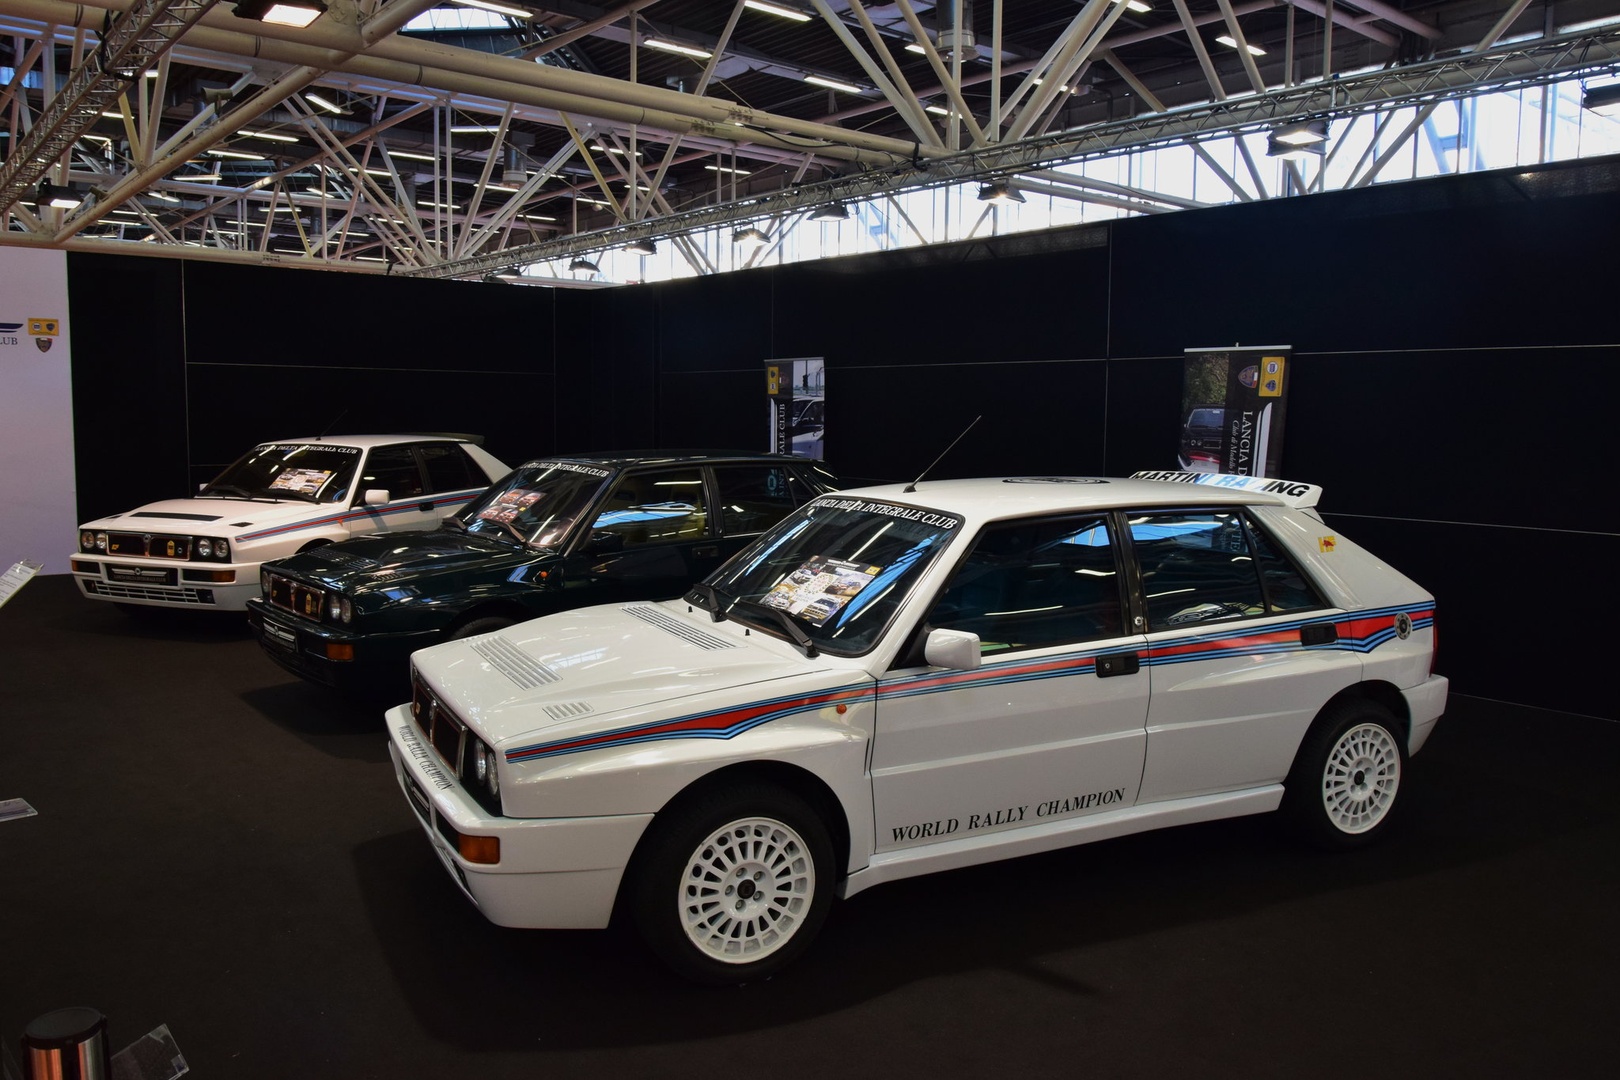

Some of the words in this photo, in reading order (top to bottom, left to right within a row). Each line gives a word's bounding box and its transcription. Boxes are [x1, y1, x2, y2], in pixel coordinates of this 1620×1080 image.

[1239, 411, 1254, 463] LANCIA
[588, 468, 610, 478] CLUB
[1131, 471, 1215, 485] MARTINI
[1217, 476, 1310, 497] RAING
[861, 502, 925, 521] INTEGRALE
[921, 513, 958, 530] CLUB
[419, 760, 455, 791] CHAMPION
[892, 818, 959, 842] WORLD
[968, 805, 1028, 830] RALLY
[1036, 788, 1126, 817] CHAMPION
